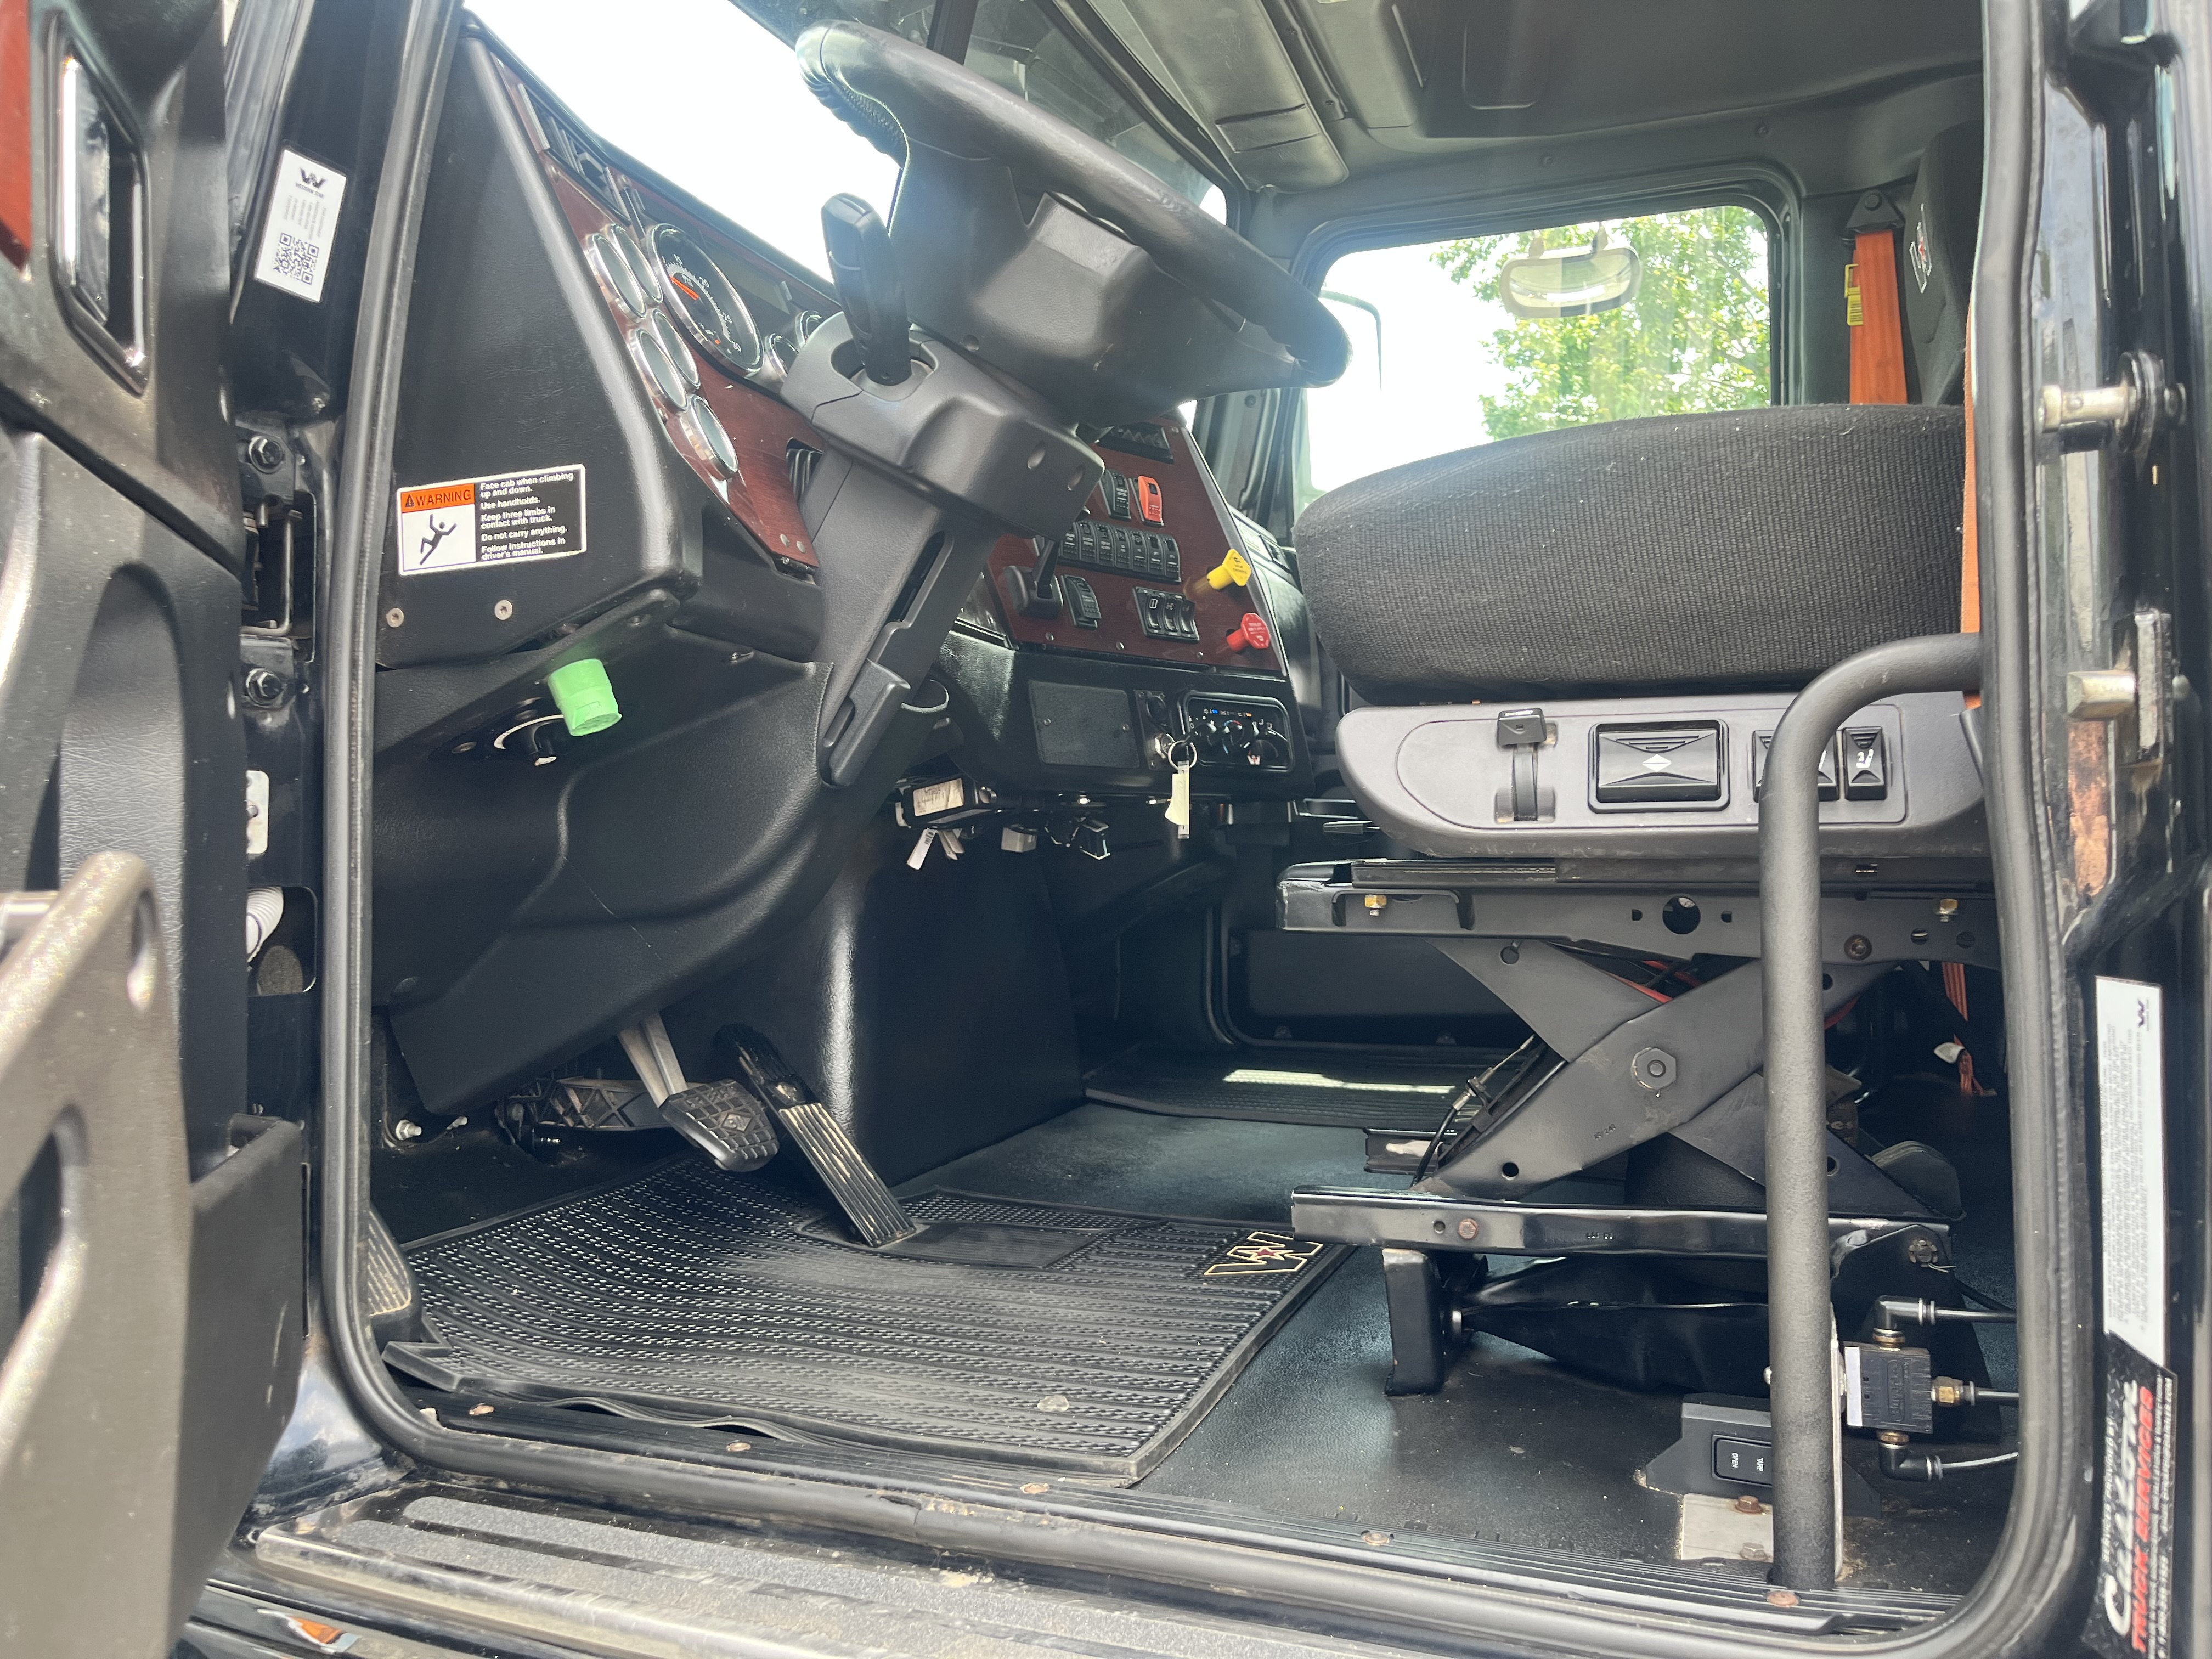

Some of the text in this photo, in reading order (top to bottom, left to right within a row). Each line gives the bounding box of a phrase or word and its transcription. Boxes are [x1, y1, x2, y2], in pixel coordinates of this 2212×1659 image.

[699, 276, 710, 288] 20
[723, 312, 732, 324] 25
[480, 472, 574, 491] Face cab when climbing
[416, 490, 471, 506] WARNING
[492, 488, 507, 496] and
[509, 486, 533, 494] down.
[498, 496, 541, 507] handholds.
[481, 514, 500, 522] Keep
[503, 511, 523, 520] three
[524, 508, 546, 516] limbs
[481, 515, 552, 529] contact with truck.
[481, 526, 567, 541] Do not carry anything.
[482, 544, 507, 554] Follow
[509, 539, 556, 550] instructions
[482, 547, 543, 560] driver's manual.
[1858, 752, 1864, 762] 3
[1731, 1452, 1740, 1468] OPEN
[2135, 1386, 2153, 1543] SERVICES
[2103, 1437, 2114, 1499] PROVIDED
[2104, 1380, 2137, 1637] Custom
[2102, 1503, 2112, 1562] SERVICES
[2131, 1543, 2148, 1653] TRUCK
